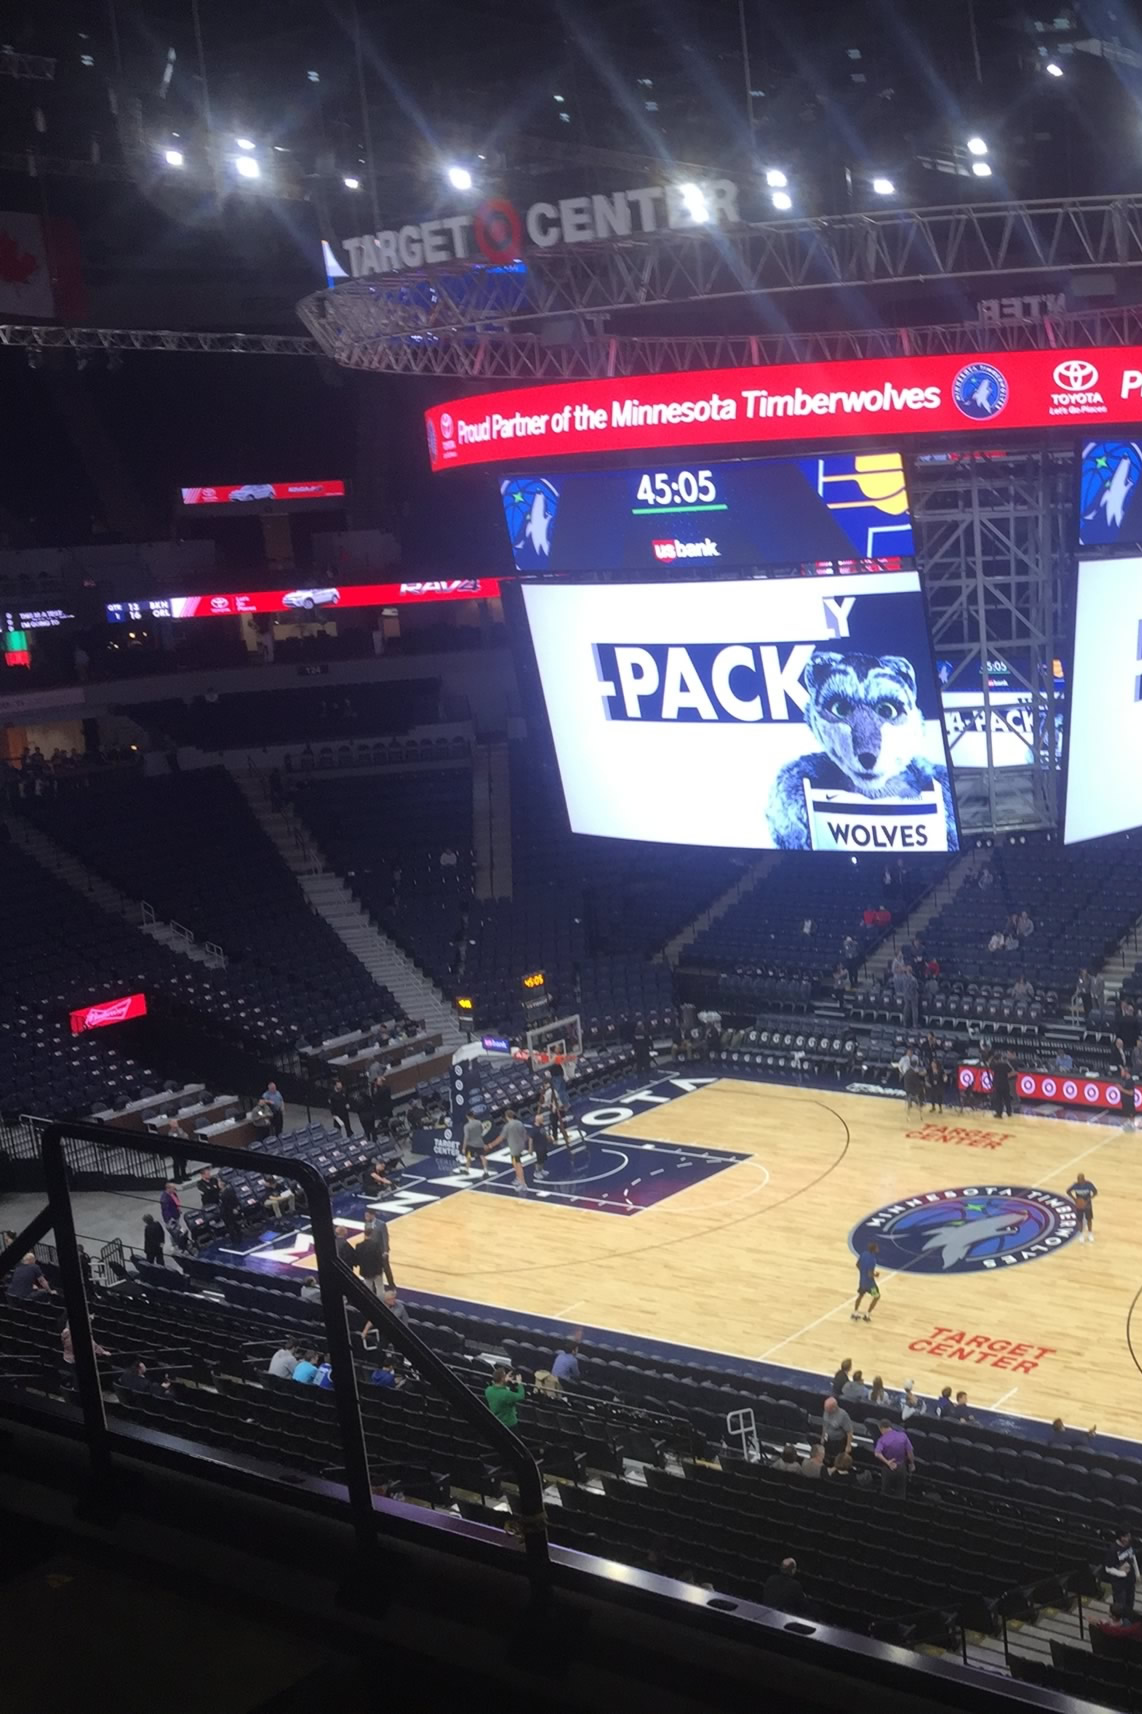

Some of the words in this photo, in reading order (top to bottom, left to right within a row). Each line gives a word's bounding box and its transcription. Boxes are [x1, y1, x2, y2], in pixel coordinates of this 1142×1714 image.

[342, 216, 475, 278] TARGET
[457, 416, 492, 445] Proud
[492, 413, 549, 440] Partner
[551, 405, 572, 434] of
[574, 403, 608, 431] the
[611, 393, 737, 428] Minnesota
[741, 382, 941, 419] Timberwolves
[1050, 391, 1105, 406] TOYOTA
[637, 469, 717, 505] 45:05
[400, 579, 482, 596] RAV4
[152, 609, 171, 618] ORL
[826, 821, 928, 848] WOLVES
[905, 1130, 1002, 1149] CENTER
[923, 1123, 1016, 1142] TARGET
[867, 1187, 1013, 1228] MINNESOTA
[983, 1190, 1078, 1268] TIMBERWOLVES
[908, 1339, 1040, 1374] CENTER
[930, 1326, 1057, 1360] TARGET
